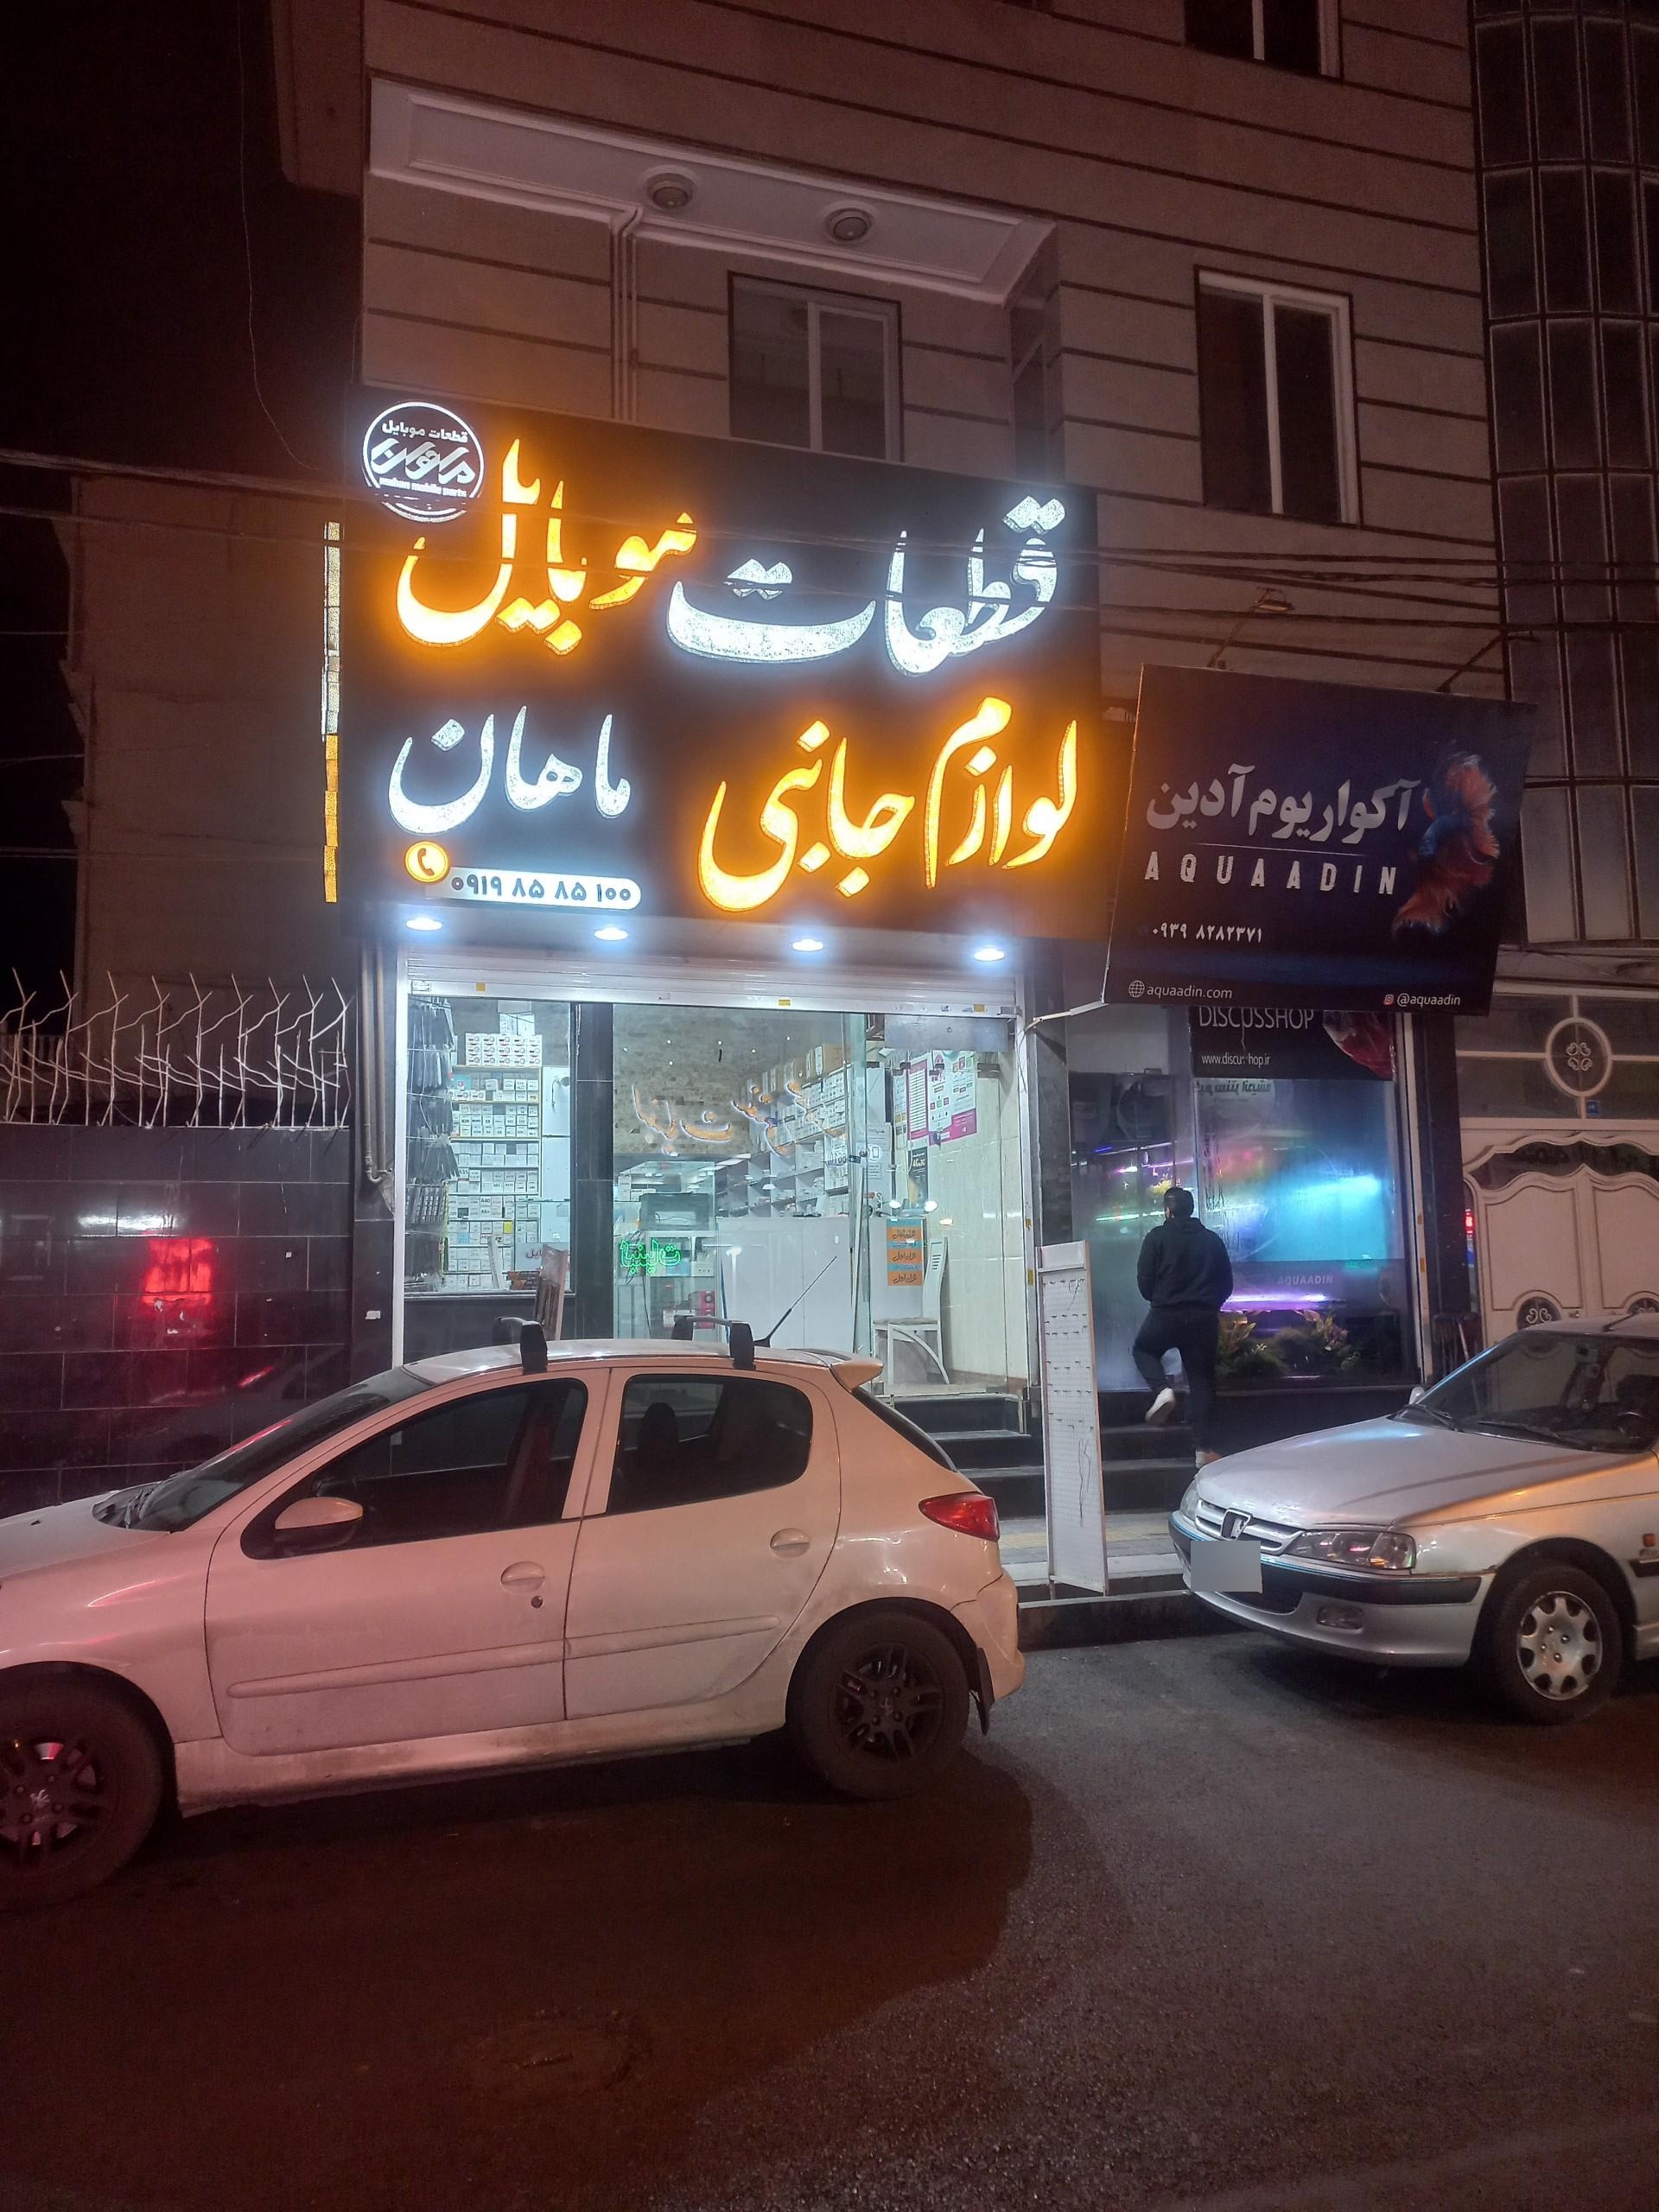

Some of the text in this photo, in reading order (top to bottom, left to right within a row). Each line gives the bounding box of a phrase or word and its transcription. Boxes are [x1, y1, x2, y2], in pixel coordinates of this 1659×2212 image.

[382, 419, 468, 443] قطعات موبایل
[371, 437, 476, 485] ماهان
[397, 438, 1065, 677] قطعات موبایل
[388, 696, 1077, 912] لوازم جانبی ماهان
[1146, 764, 1421, 844] آکواریوم آدین
[451, 874, 632, 902] ۰۹۱۹ ۸۵ ۸۵ ۱۰۰
[1153, 922, 1187, 939] ۰۹۳۹
[1147, 985, 1233, 1000] aquaadin.com
[1396, 992, 1461, 1007] @aquaadin
[1199, 1006, 1314, 1029] DISCUSSHOP
[1201, 1052, 1271, 1068] www.discuhop.ir
